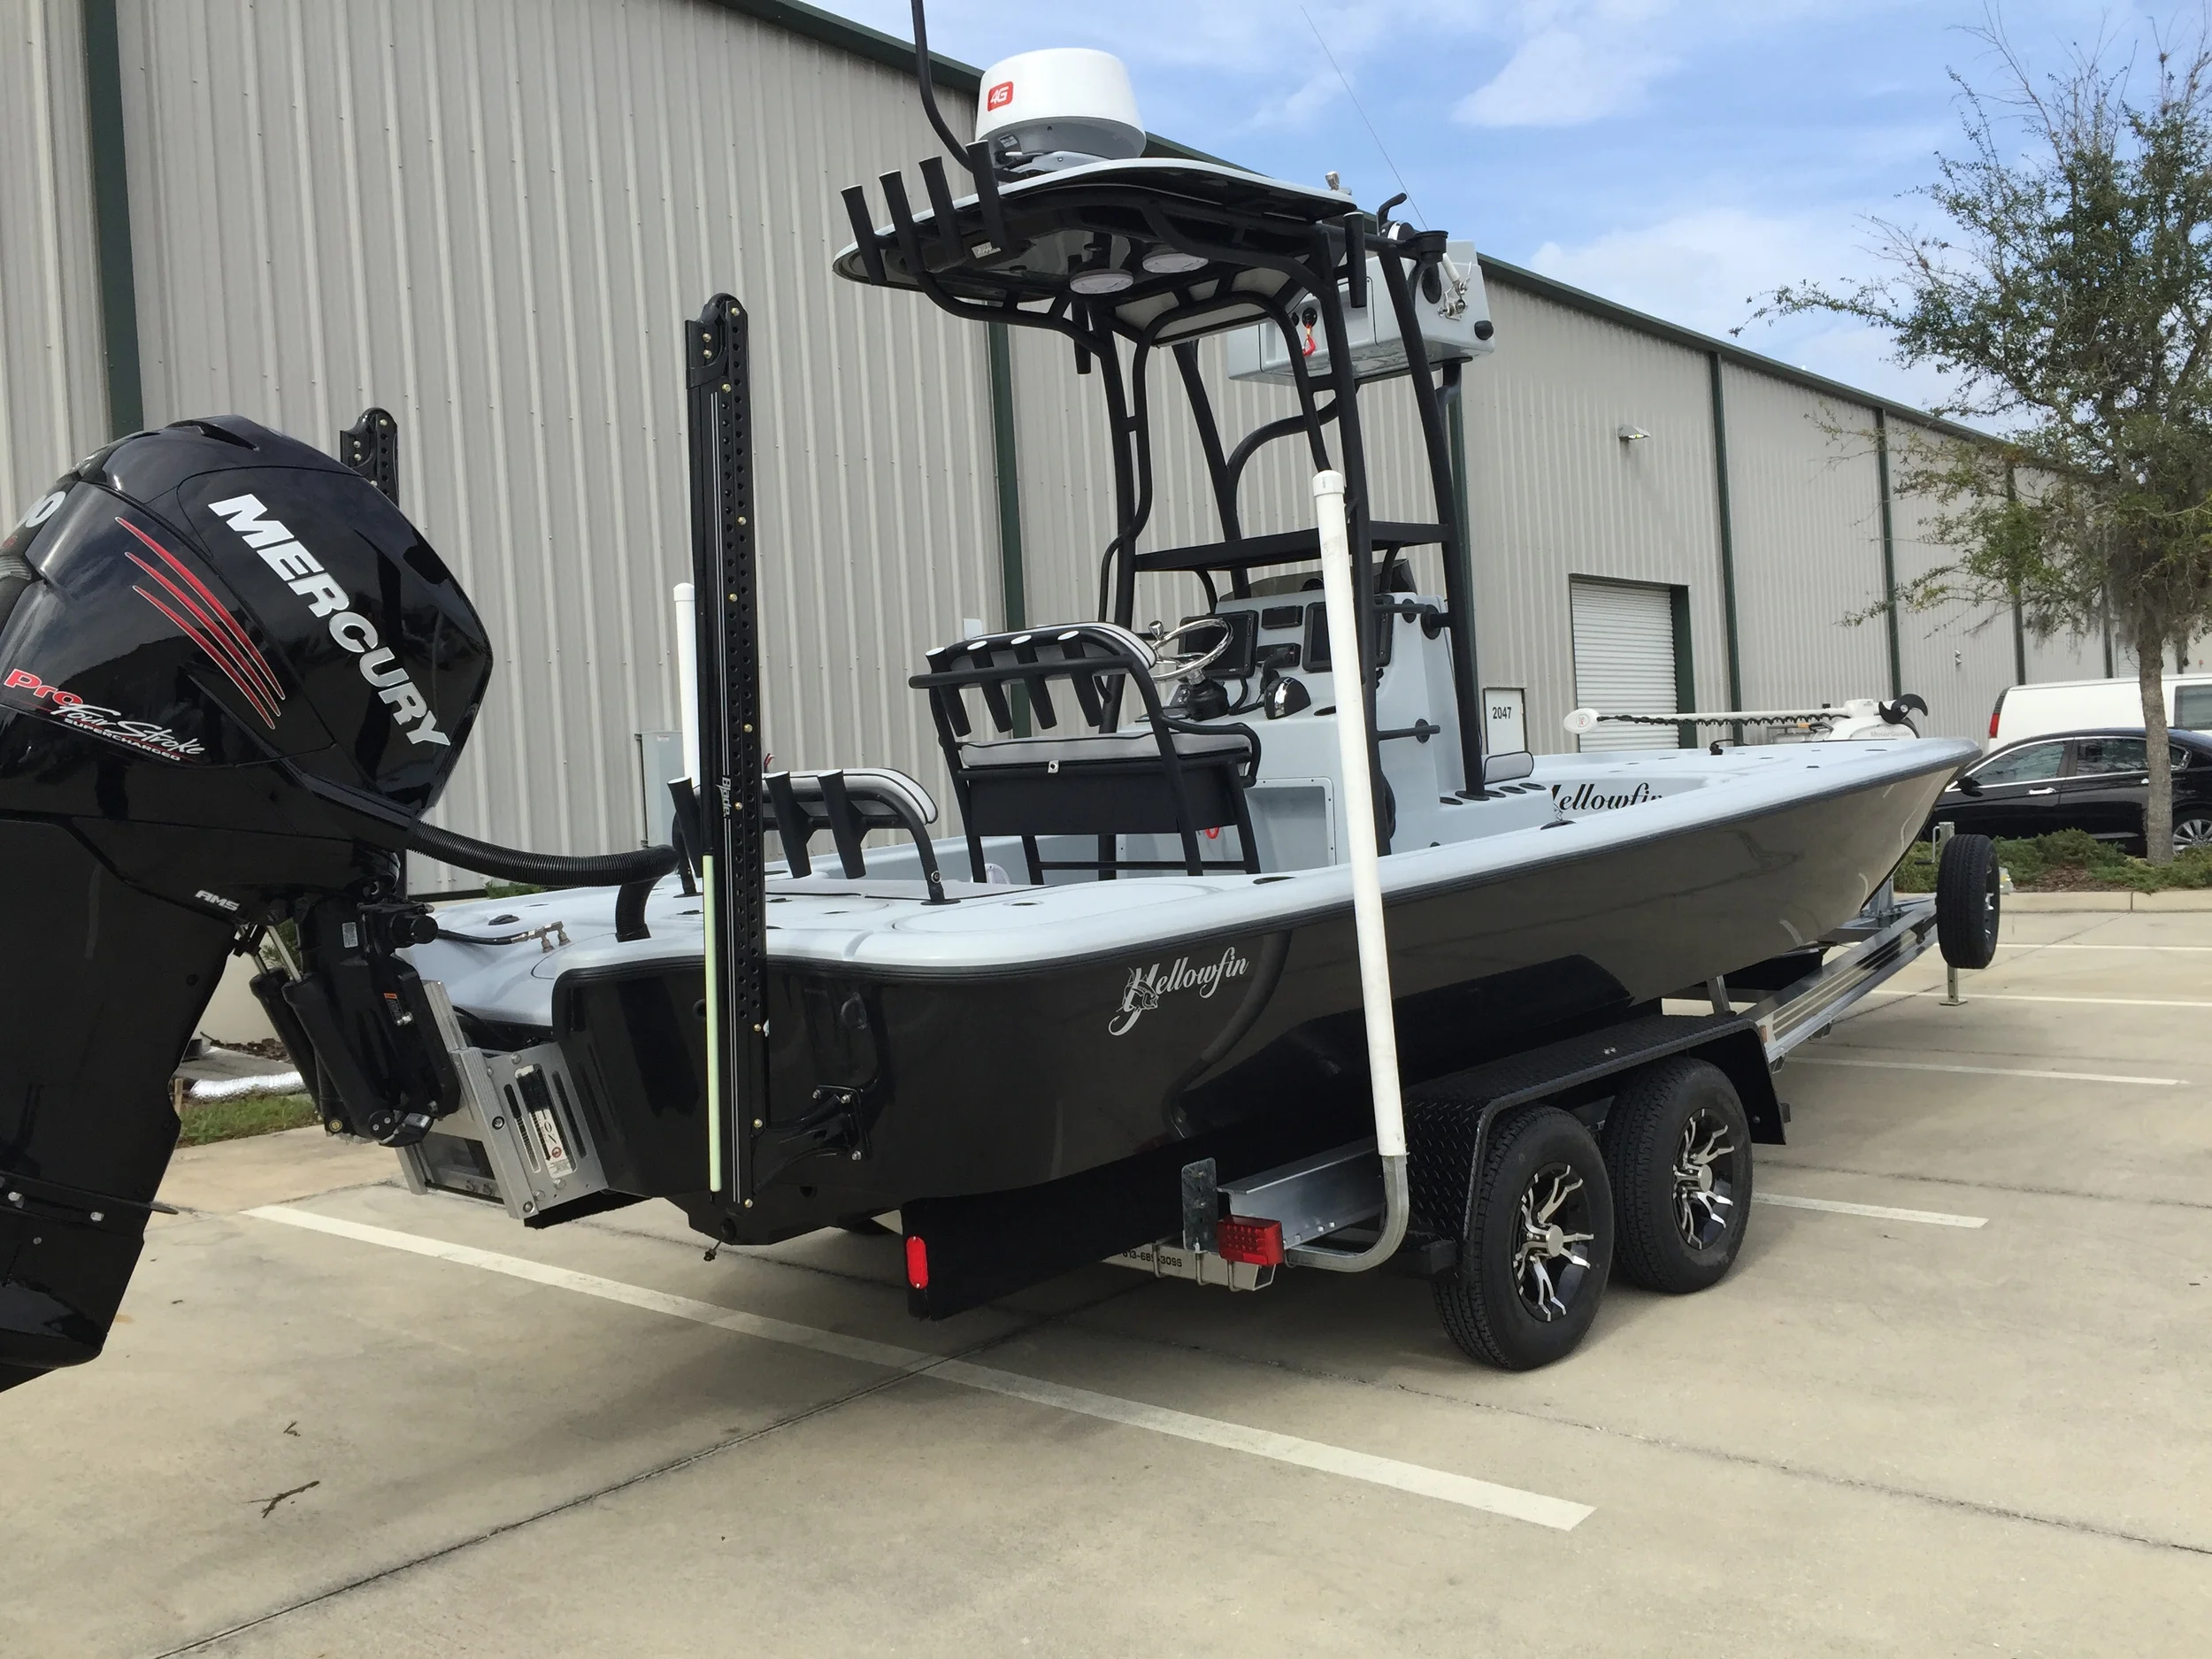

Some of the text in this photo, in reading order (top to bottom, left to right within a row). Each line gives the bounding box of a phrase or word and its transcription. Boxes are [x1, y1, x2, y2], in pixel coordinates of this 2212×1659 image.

[990, 85, 1010, 104] 4G
[208, 493, 451, 746] MERCURY
[4, 668, 83, 707] Pro
[1492, 706, 1512, 719] 2047
[64, 717, 181, 761] SUPERCHARGED
[715, 776, 732, 818] Blade
[1550, 782, 1663, 810] ellowfi
[195, 889, 241, 911] AMS
[1108, 946, 1249, 1036] Yellowfin
